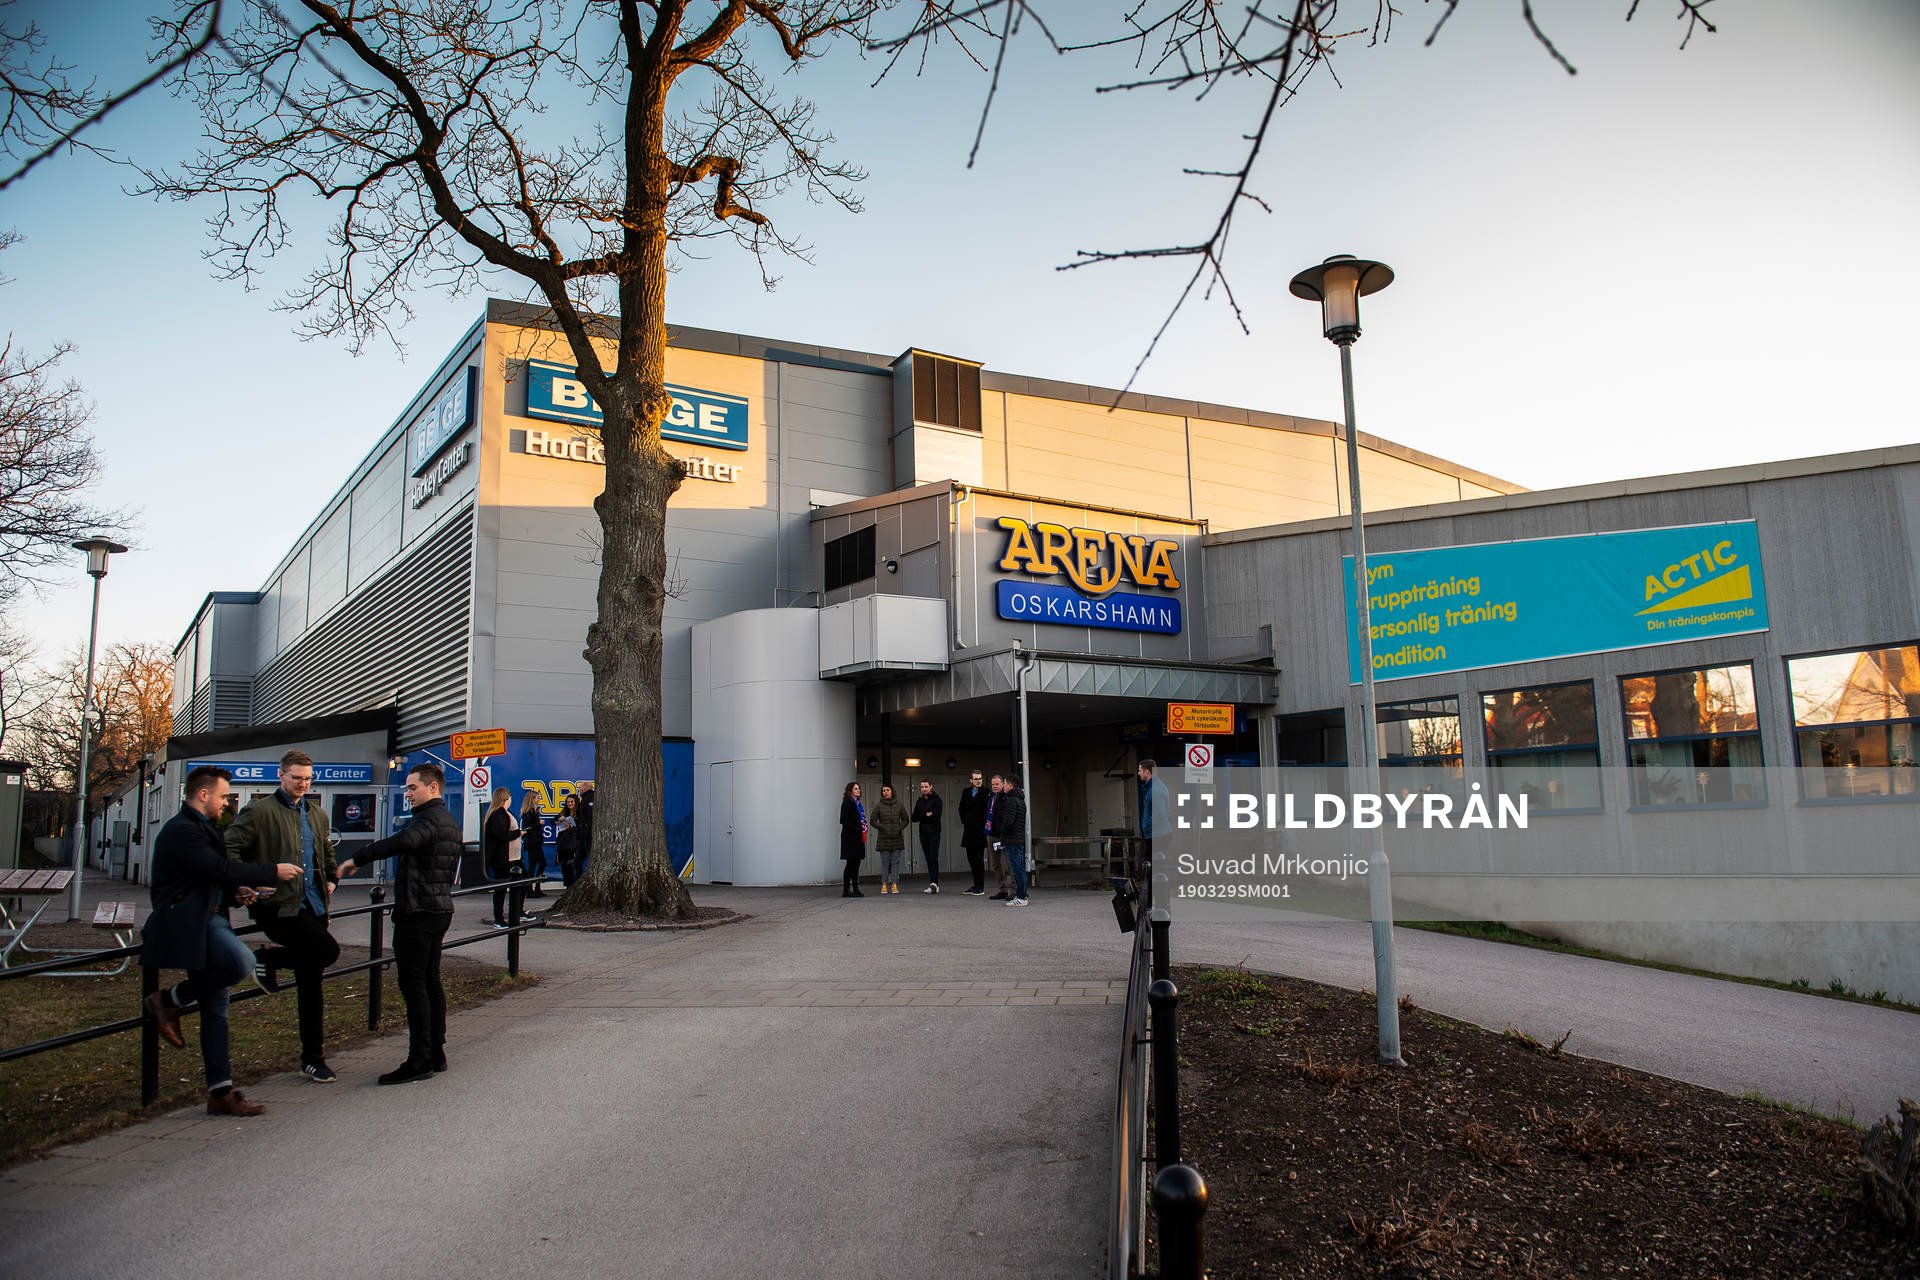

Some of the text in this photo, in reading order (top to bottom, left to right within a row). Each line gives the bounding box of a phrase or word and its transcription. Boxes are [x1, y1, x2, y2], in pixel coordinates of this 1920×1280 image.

[411, 441, 471, 509] Hockey Center
[525, 428, 743, 483] Hock nter
[998, 516, 1182, 594] ARENA
[1645, 540, 1737, 601] ACTIC
[1011, 593, 1172, 627] OSKARSHAMN
[1369, 601, 1518, 640] ersonlig träning
[1647, 606, 1755, 631] Din träningskompis
[1372, 643, 1447, 669] ondition
[325, 768, 366, 779] Center
